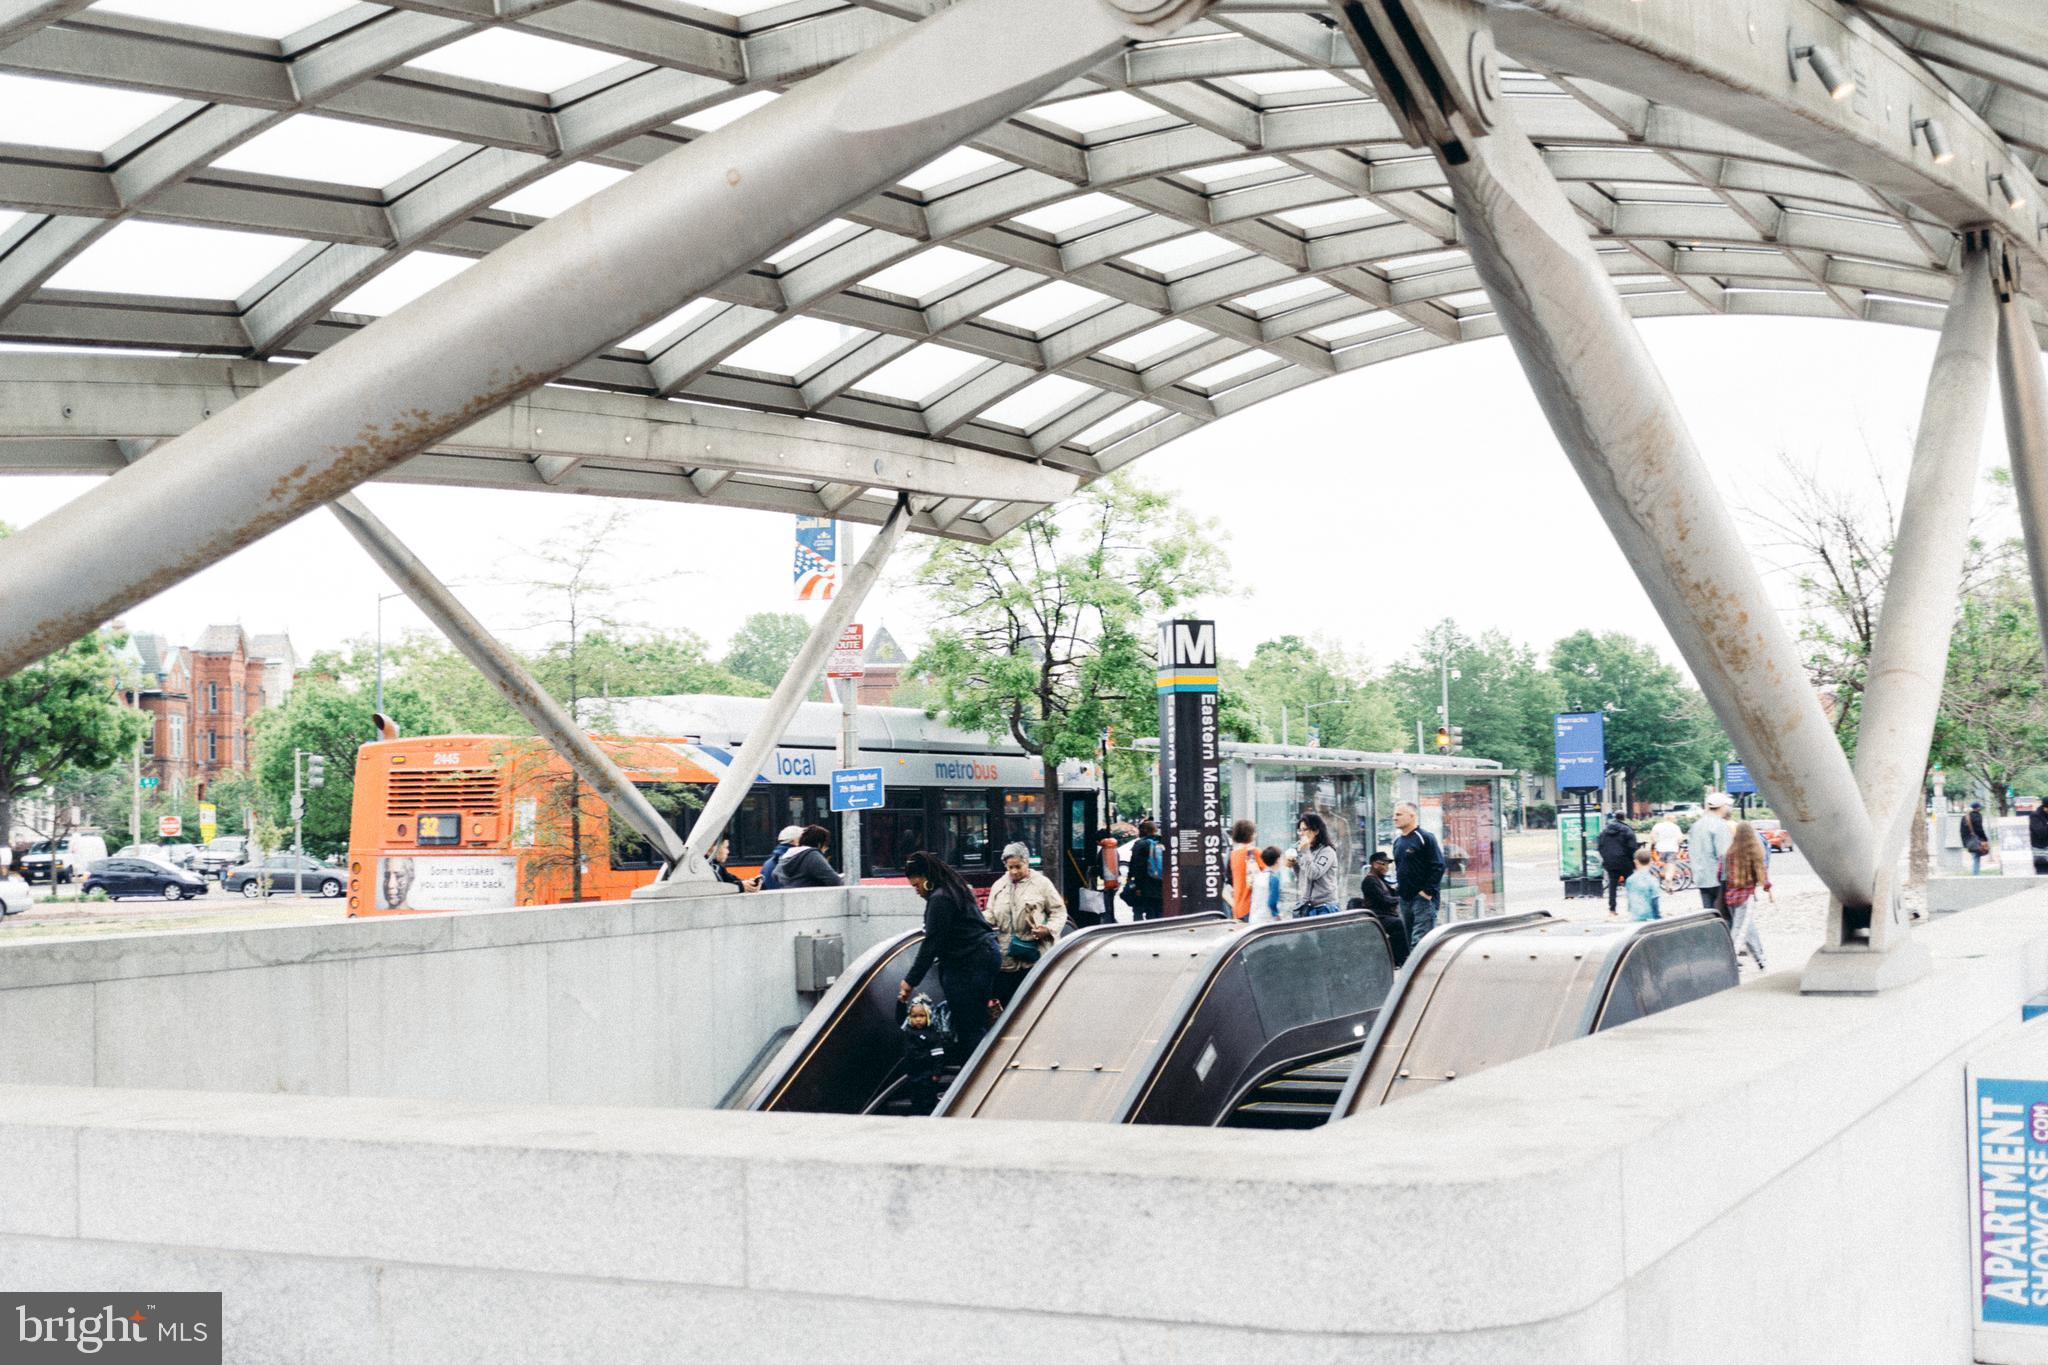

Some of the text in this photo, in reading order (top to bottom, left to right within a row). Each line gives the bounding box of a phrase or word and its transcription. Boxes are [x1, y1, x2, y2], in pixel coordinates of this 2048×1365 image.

[1158, 625, 1174, 667] M
[1175, 624, 1215, 665] M
[776, 752, 816, 776] local
[935, 760, 998, 780] metrobus
[1167, 694, 1180, 898] Eastern Market Station
[1201, 693, 1220, 898] Eastern Market Station
[420, 817, 439, 837] 32
[420, 881, 436, 892] you
[461, 880, 480, 889] take
[430, 866, 495, 876] Some mistakes
[1980, 1097, 2029, 1306] APARTMENT
[2028, 1148, 2048, 1306] SHOWCASE
